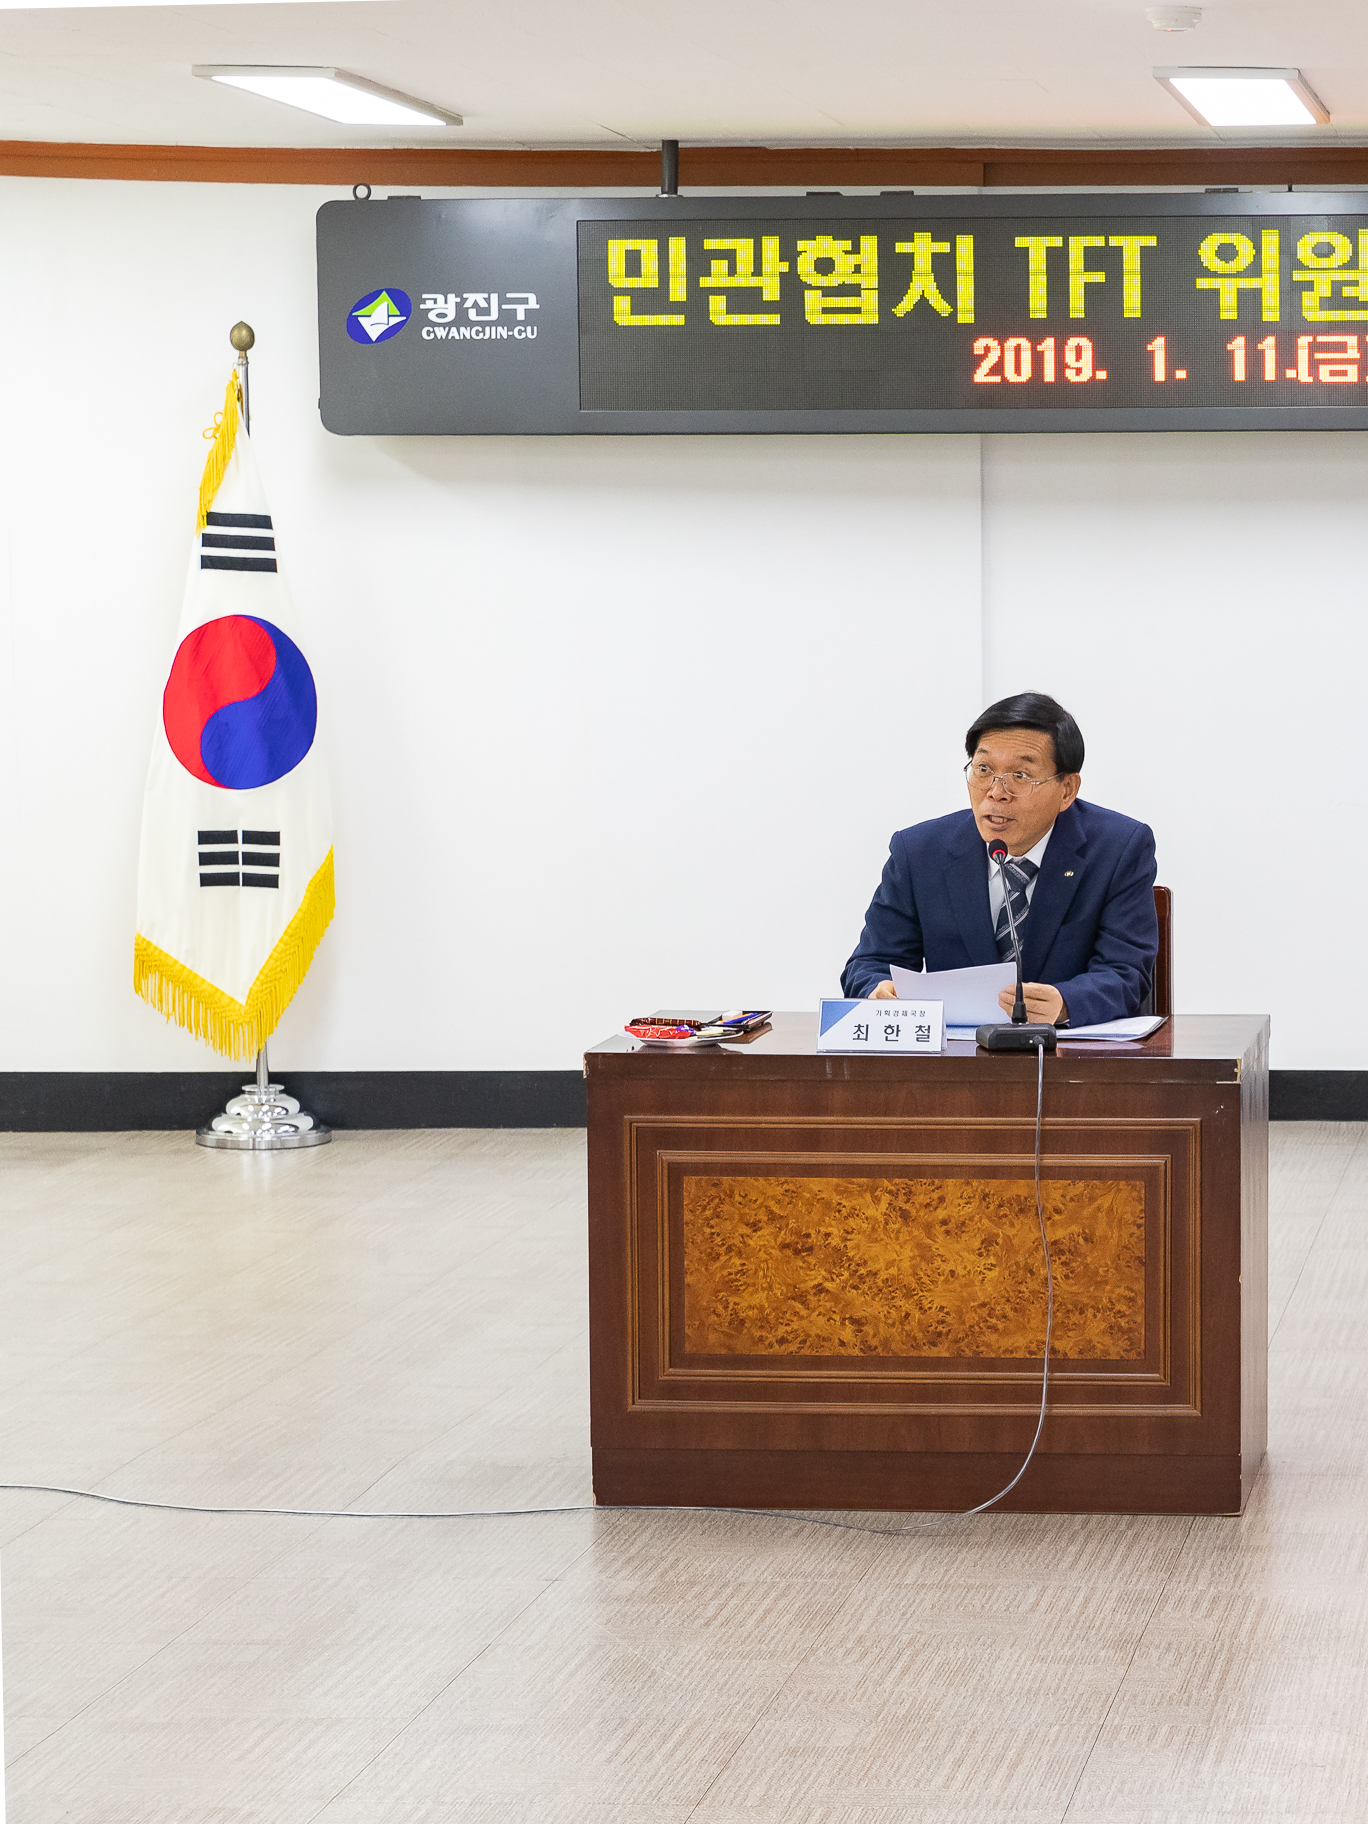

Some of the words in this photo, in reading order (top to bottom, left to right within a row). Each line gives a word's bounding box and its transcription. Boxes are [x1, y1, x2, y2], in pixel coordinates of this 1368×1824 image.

[607, 232, 974, 327] 민관협치
[1014, 235, 1157, 318] TFT
[419, 292, 541, 324] 광진구
[421, 326, 538, 341] GWANGJIN-GU
[972, 336, 1108, 383] 2019.
[1146, 335, 1187, 382] 1.
